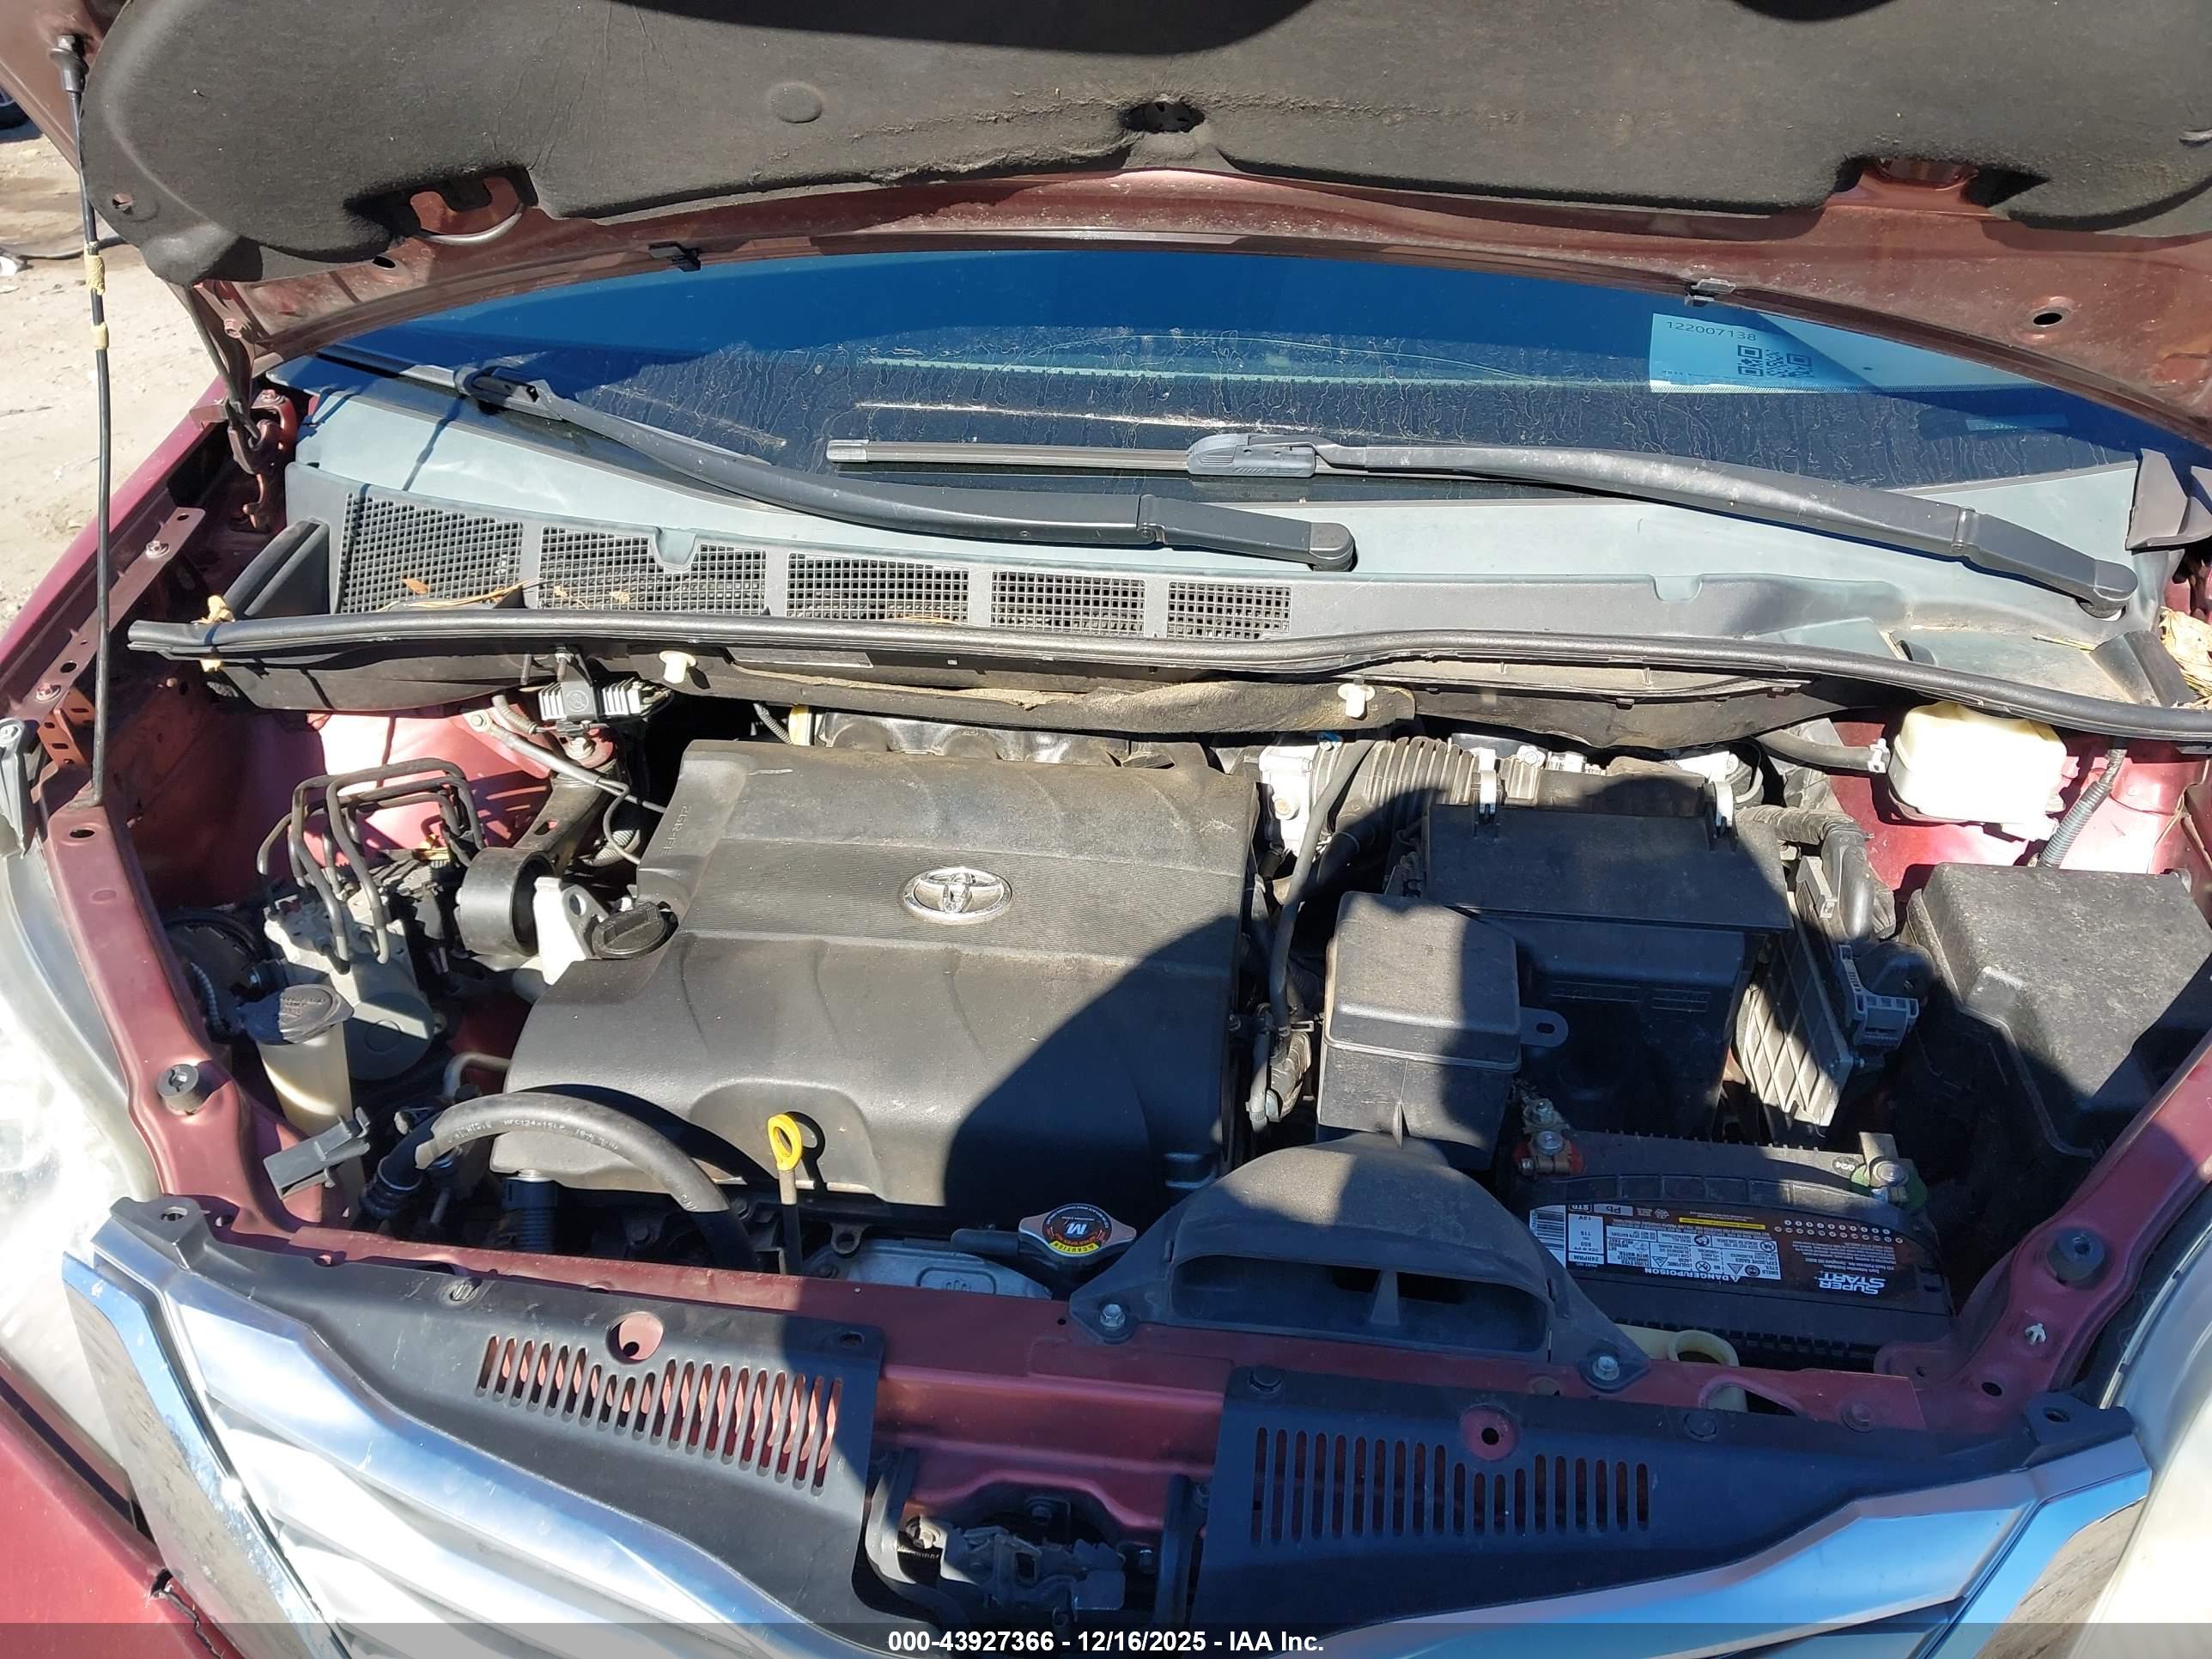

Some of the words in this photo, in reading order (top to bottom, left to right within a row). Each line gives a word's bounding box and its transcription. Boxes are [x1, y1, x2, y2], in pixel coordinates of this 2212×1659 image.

[1667, 322, 1756, 340] 122007138
[1054, 1243, 1087, 1252] CAUTION
[1644, 1267, 1729, 1281] DANGER/POISON
[1817, 1272, 1886, 1288] START
[1819, 1281, 1878, 1294] SUPER
